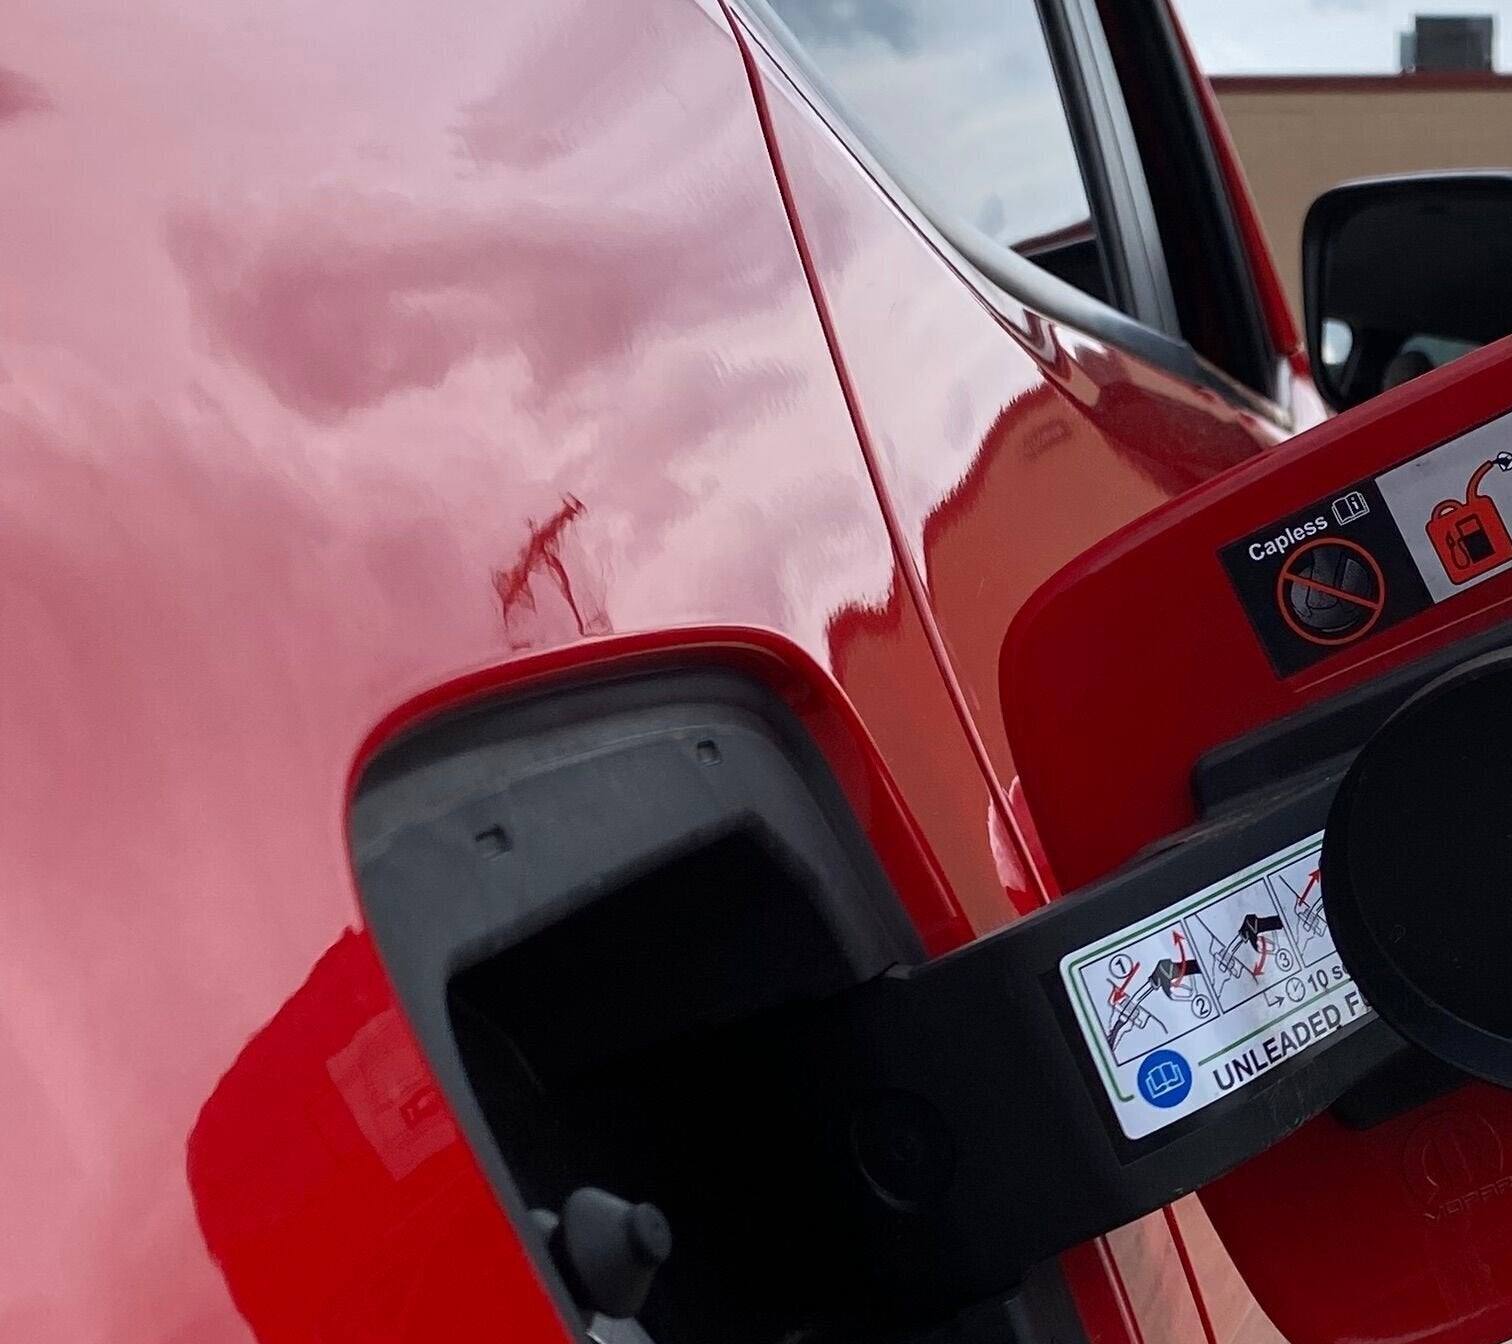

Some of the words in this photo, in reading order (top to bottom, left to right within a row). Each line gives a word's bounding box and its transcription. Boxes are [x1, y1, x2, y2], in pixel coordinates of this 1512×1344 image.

[1248, 513, 1329, 562] Capless
[1307, 968, 1329, 993] 10
[1212, 1004, 1342, 1091] UNLEADED
